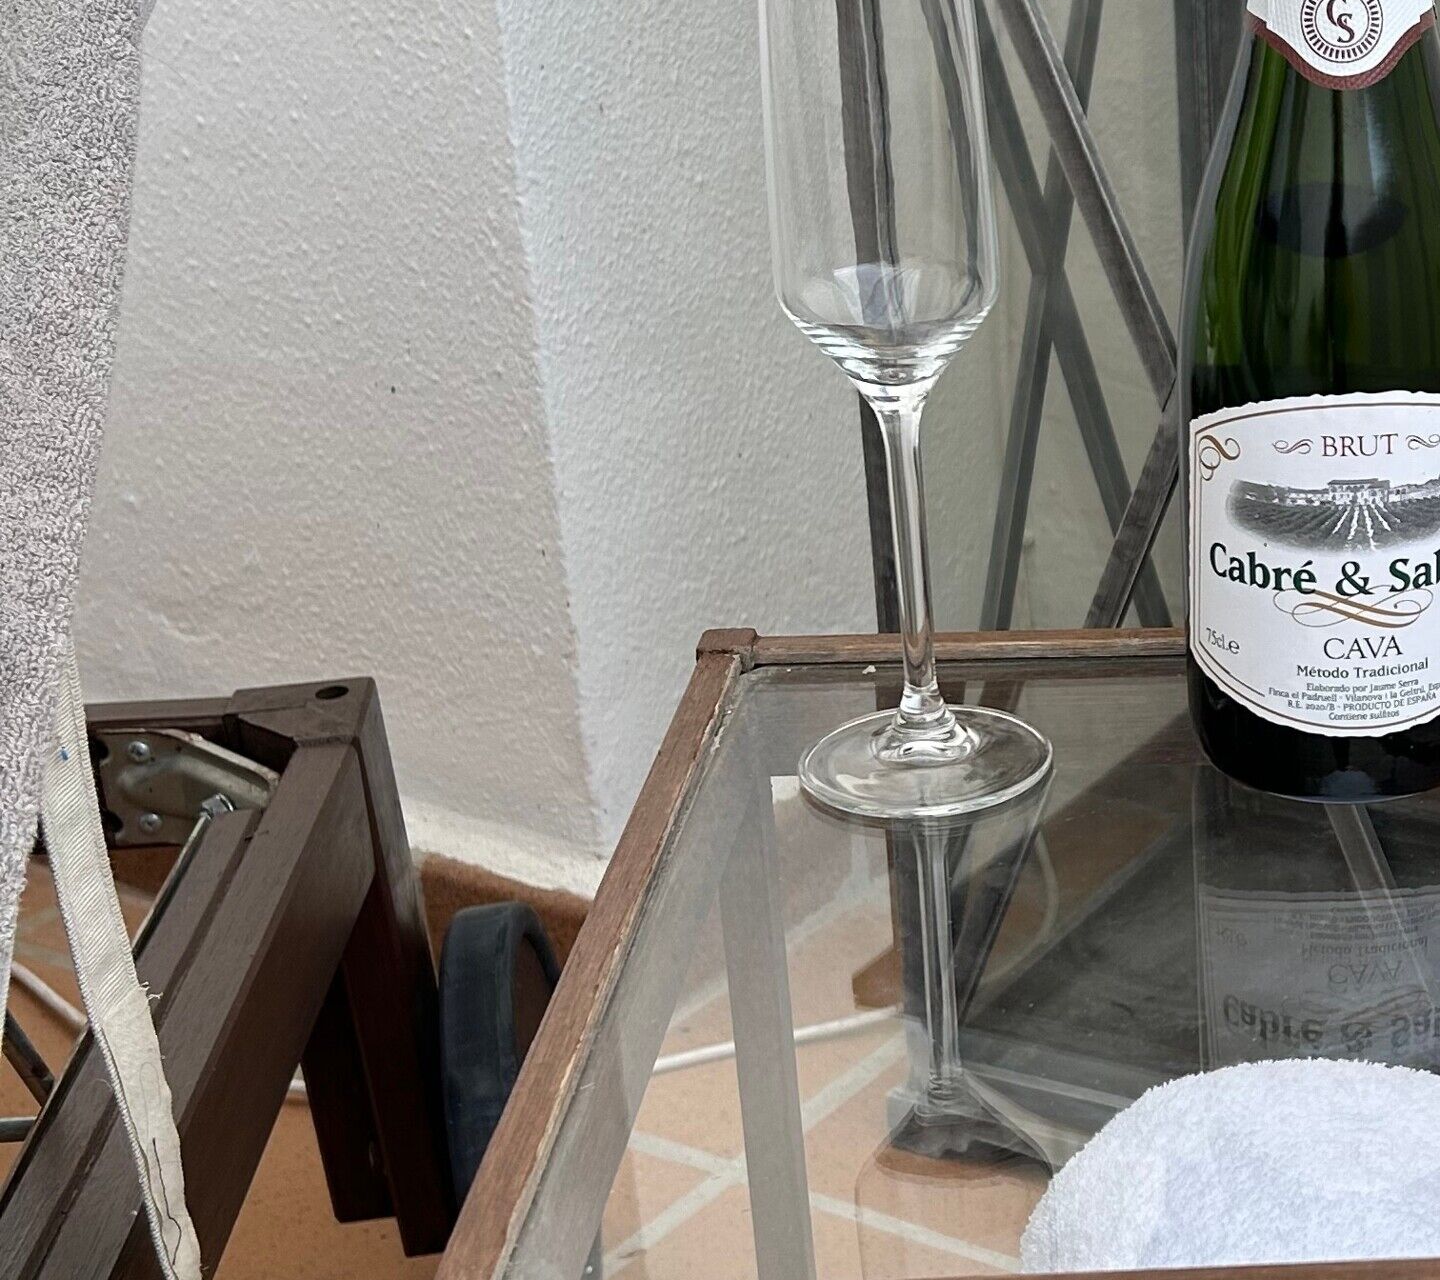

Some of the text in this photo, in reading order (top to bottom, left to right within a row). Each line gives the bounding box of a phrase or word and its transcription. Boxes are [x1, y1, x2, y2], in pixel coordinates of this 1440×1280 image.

[1321, 433, 1399, 457] BRUT
[1209, 542, 1318, 594] Cabré
[1335, 561, 1374, 596] &
[1323, 634, 1403, 660] CAVA
[1296, 657, 1429, 679] Método Tradicional
[1306, 682, 1350, 693] Elaborado
[1352, 684, 1368, 694] por
[1398, 678, 1419, 689] Serra
[1343, 701, 1391, 711] PRODUCTO
[1393, 699, 1404, 708] DE
[1345, 693, 1382, 702] Vilanova
